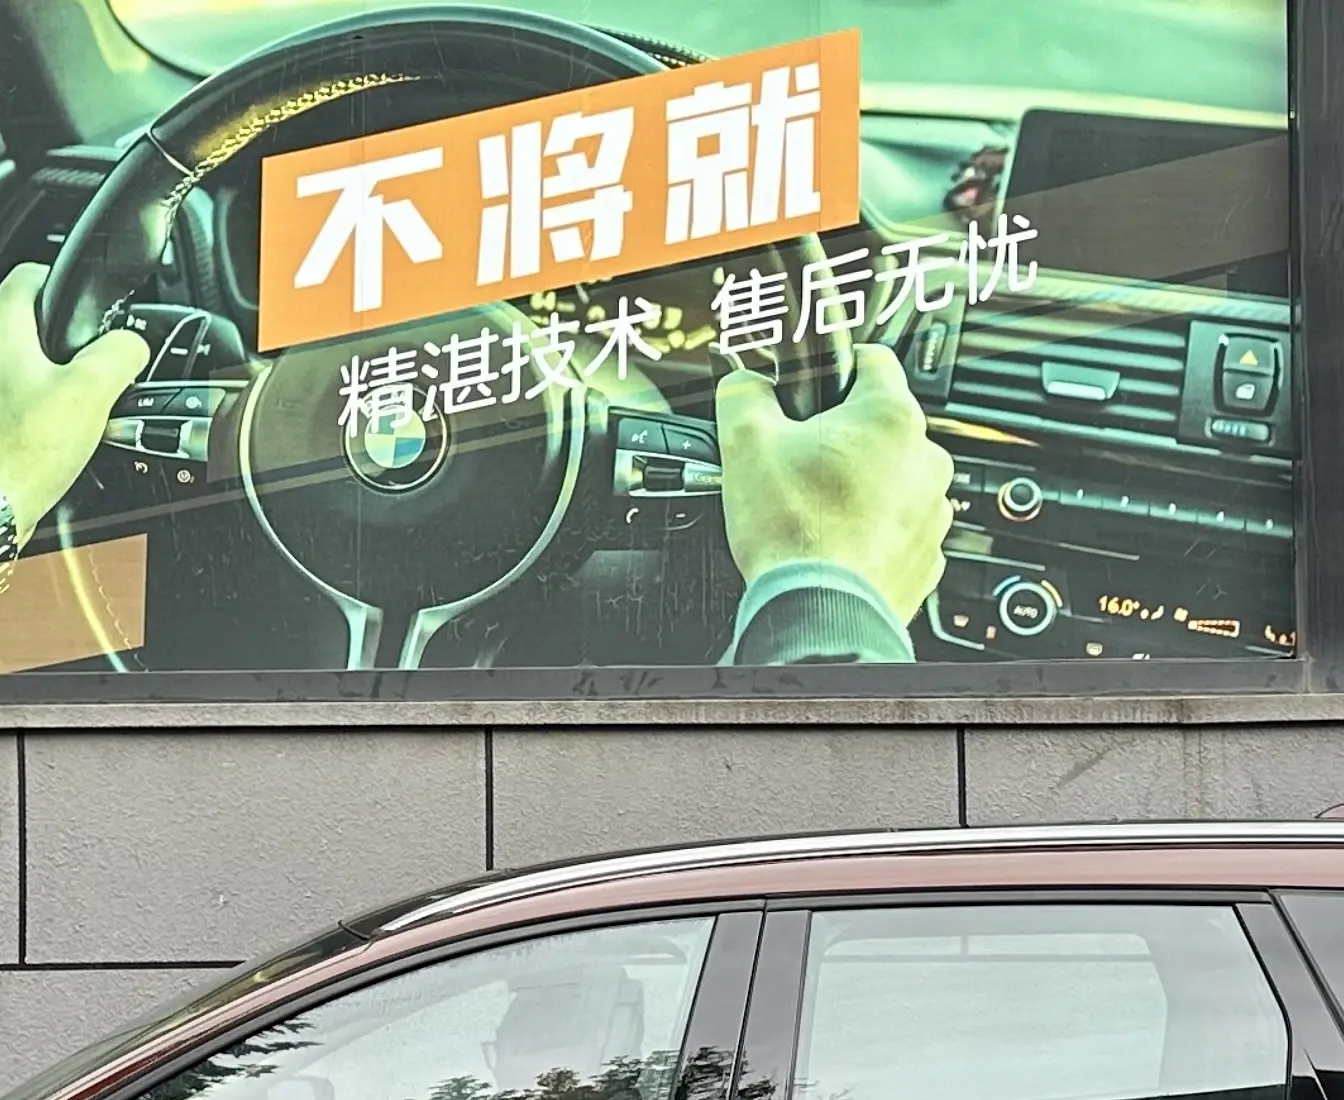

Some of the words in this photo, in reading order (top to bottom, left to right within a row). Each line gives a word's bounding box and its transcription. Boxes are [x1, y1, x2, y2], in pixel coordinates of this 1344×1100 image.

[293, 62, 822, 314] 不将就
[710, 213, 1040, 354] 售后无忧
[338, 296, 663, 438] 精湛技术
